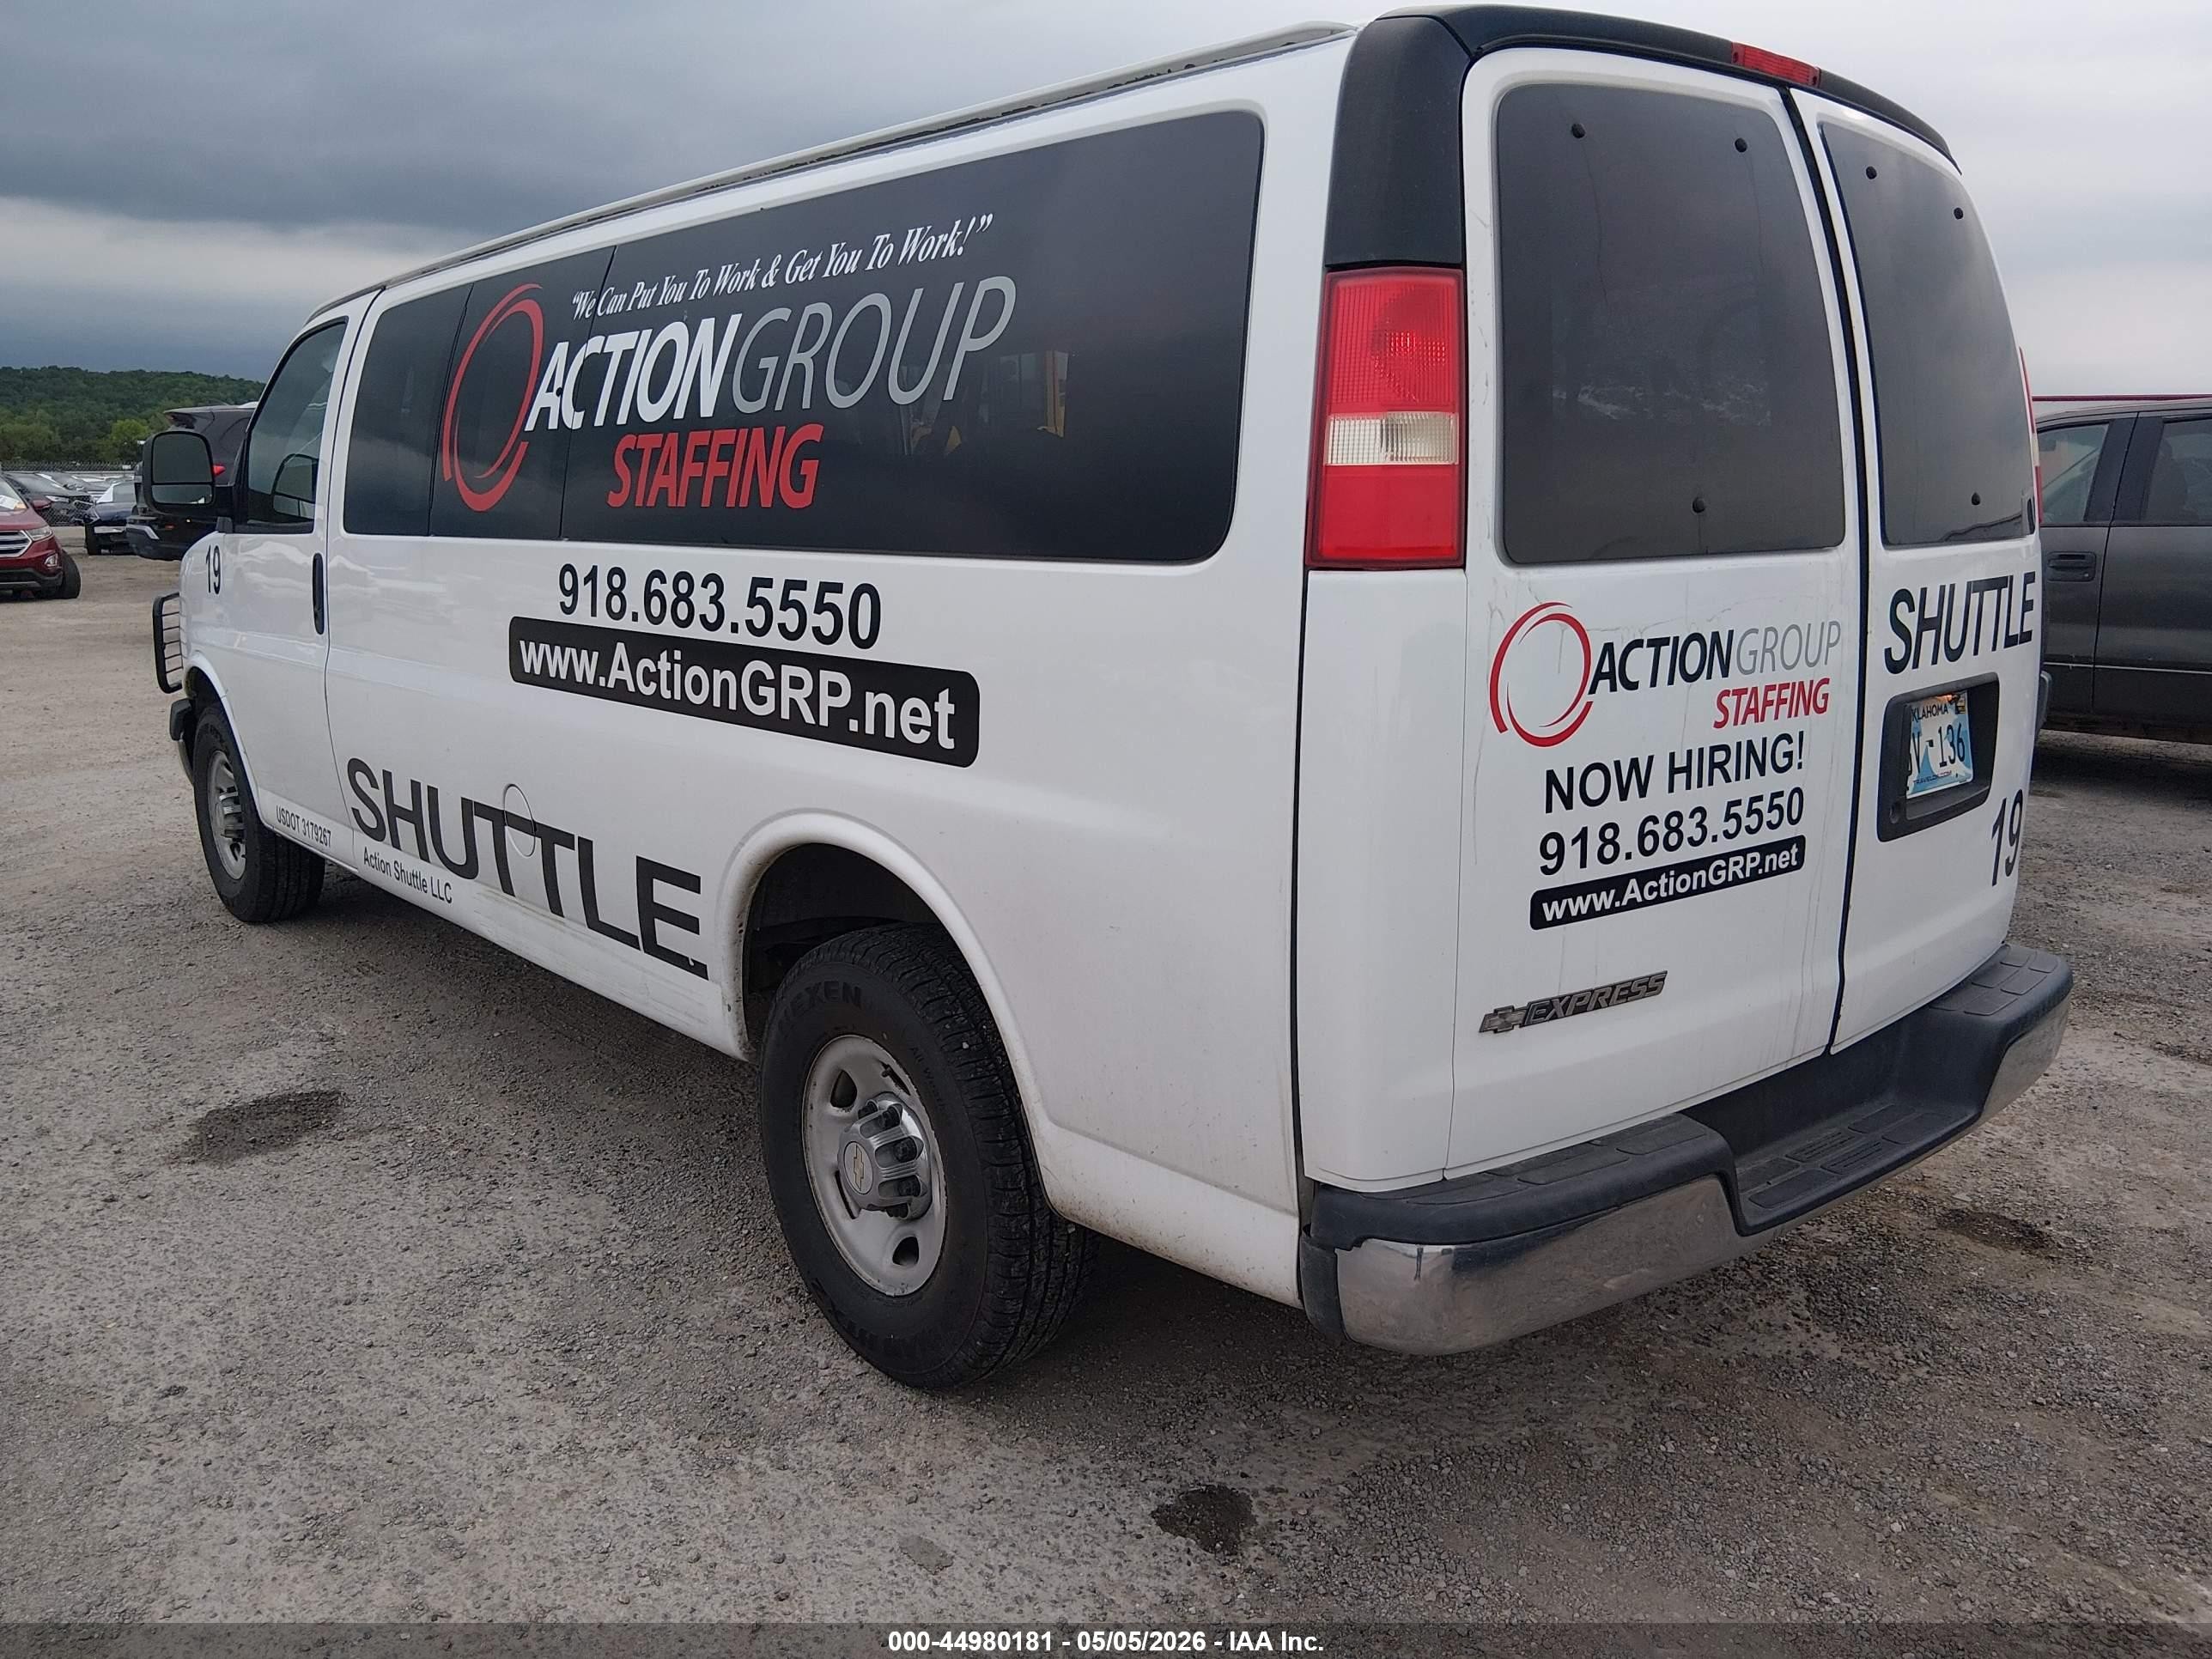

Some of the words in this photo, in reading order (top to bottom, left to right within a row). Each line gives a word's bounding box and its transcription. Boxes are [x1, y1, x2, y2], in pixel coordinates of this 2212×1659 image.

[597, 287, 628, 316] Can
[626, 278, 659, 312] Put
[657, 275, 688, 307] You
[689, 269, 711, 301] To
[712, 258, 762, 295] Work
[761, 254, 782, 288] &
[785, 249, 823, 284] Get
[822, 242, 863, 278] You
[865, 233, 894, 270] To
[606, 423, 824, 509] STAFFING
[205, 544, 222, 595] 19
[558, 562, 882, 650] 918.683.5550
[1883, 570, 2036, 675] SHUTTLE
[519, 640, 956, 750] www.ActionGRP.net
[1712, 677, 1831, 730] STAFFING
[1910, 703, 1949, 723] KLAHOMA
[1544, 755, 1655, 815] NOW
[1667, 730, 1805, 794] HIRING!
[276, 805, 301, 834] USDOT
[301, 817, 332, 848] 3179267
[1538, 786, 1805, 877] 918.683.5550
[1990, 788, 2024, 887] 19
[346, 757, 710, 981] SHUTTLE
[363, 846, 392, 878] Action
[393, 860, 428, 894] Shuttle
[429, 876, 453, 904] LLC
[1541, 842, 1799, 922] www.ActionGRP.net
[1525, 972, 1668, 1027] EXPRESS
